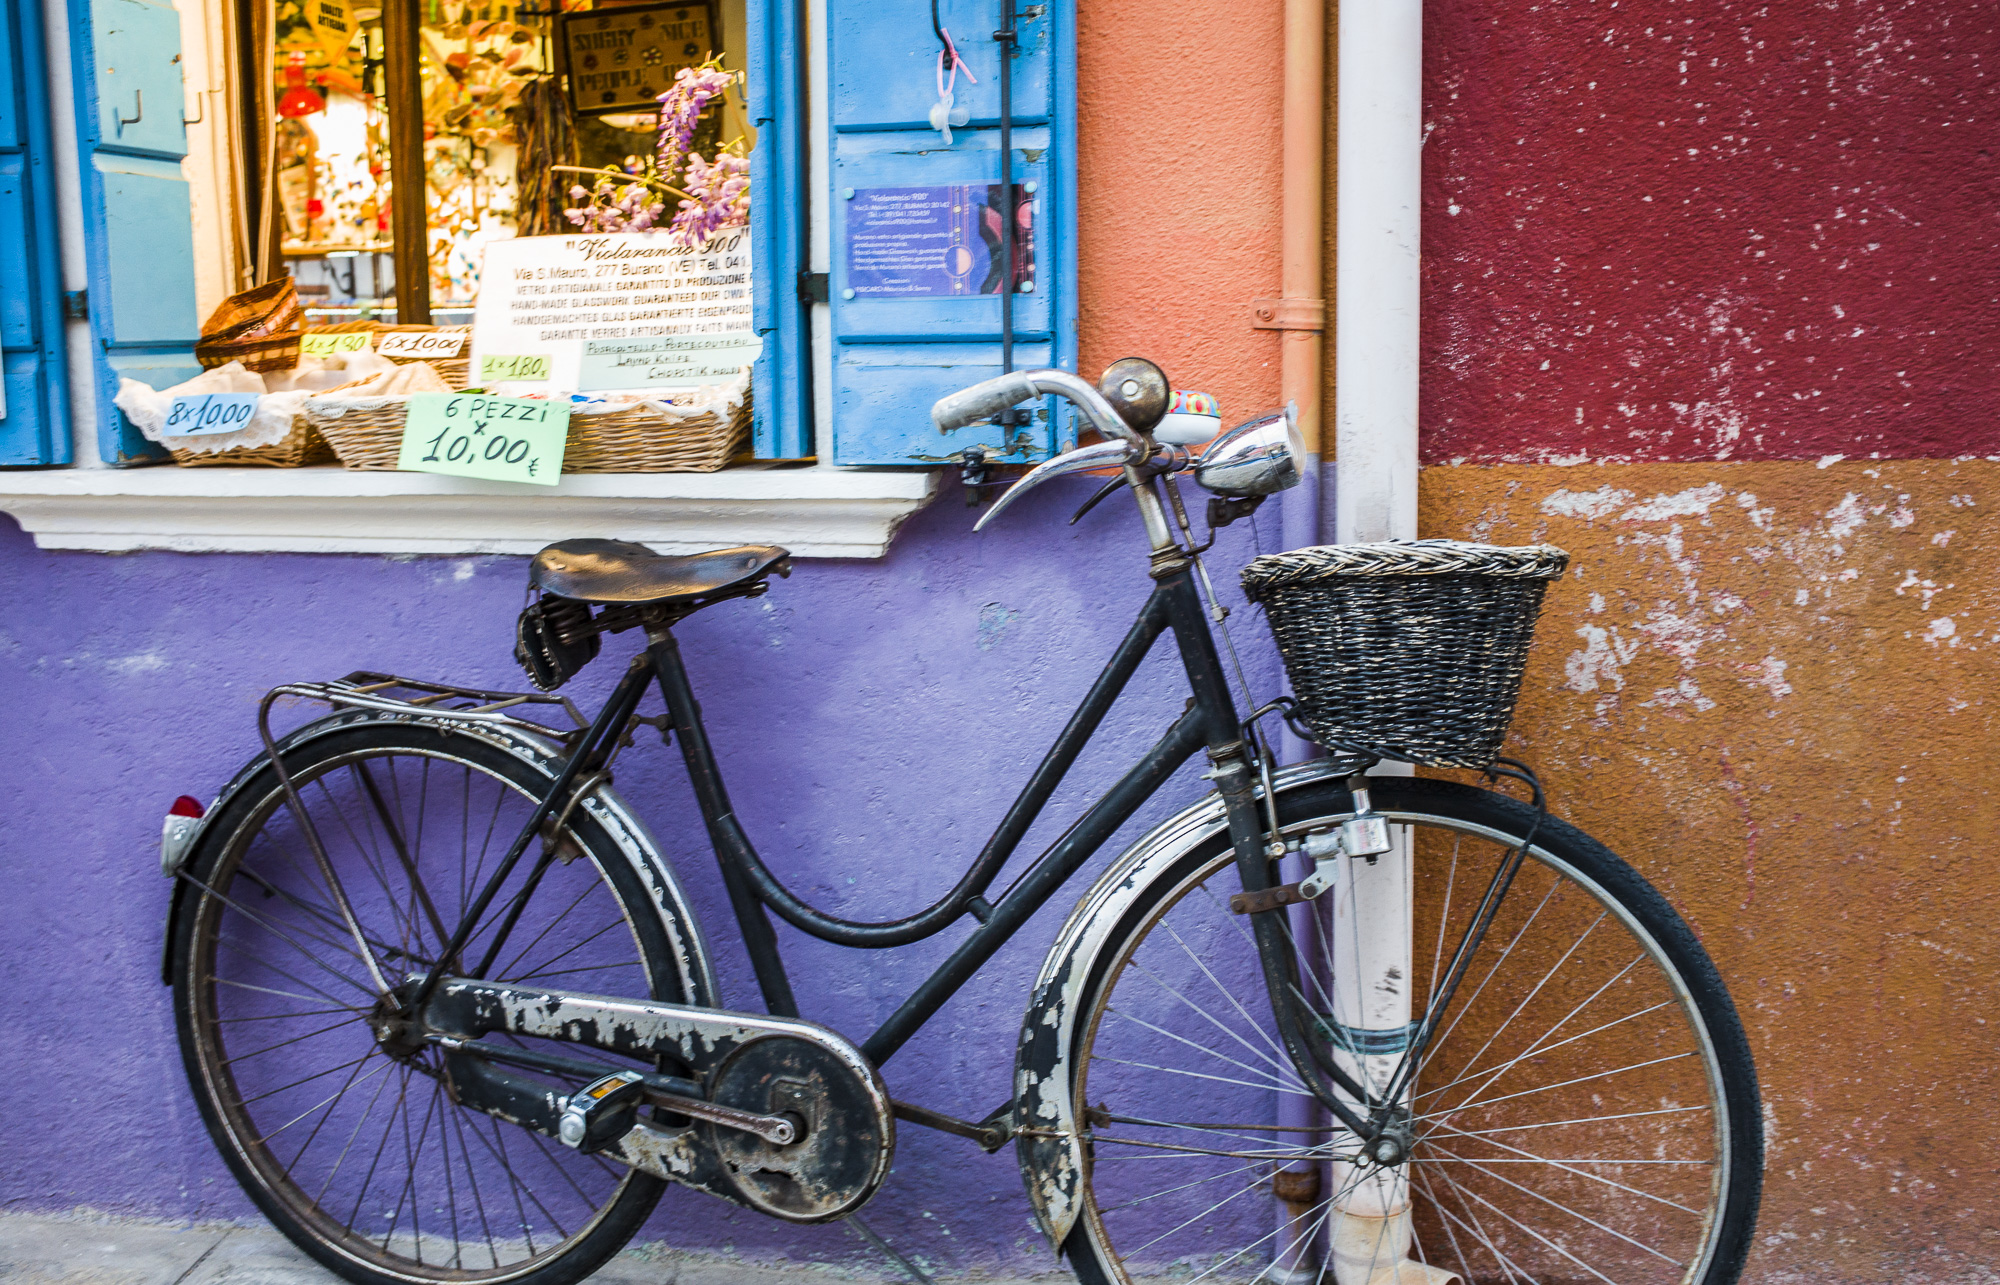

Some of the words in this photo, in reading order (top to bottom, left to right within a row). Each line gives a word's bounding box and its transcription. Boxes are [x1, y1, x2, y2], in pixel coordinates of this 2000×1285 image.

[661, 20, 704, 41] NICE
[577, 67, 649, 91] PEOPLE
[514, 268, 533, 279] Via
[595, 264, 617, 277] 277
[622, 262, 665, 275] Burano
[670, 258, 696, 276] (VE)
[518, 285, 547, 295] VETRO
[550, 282, 612, 294] ARTIGIANALE
[616, 279, 671, 291] GARANTITO
[674, 278, 683, 288] DI
[686, 273, 745, 286] PRODUZIONE
[511, 299, 568, 310] HAND-MADE
[572, 296, 629, 308] GLASSWORK
[633, 292, 698, 305] GUARANTEED
[701, 290, 719, 301] OUR
[724, 289, 745, 299] OWN
[513, 313, 598, 325] HANDGEMACHTES
[602, 312, 626, 322] GLAS
[629, 307, 694, 321] GARANTIERTE
[540, 328, 588, 341] GARANTIE
[592, 327, 627, 339] VERRES
[630, 324, 692, 336] ARTISANAUX
[696, 321, 722, 333] FAITS
[445, 397, 464, 418] 6
